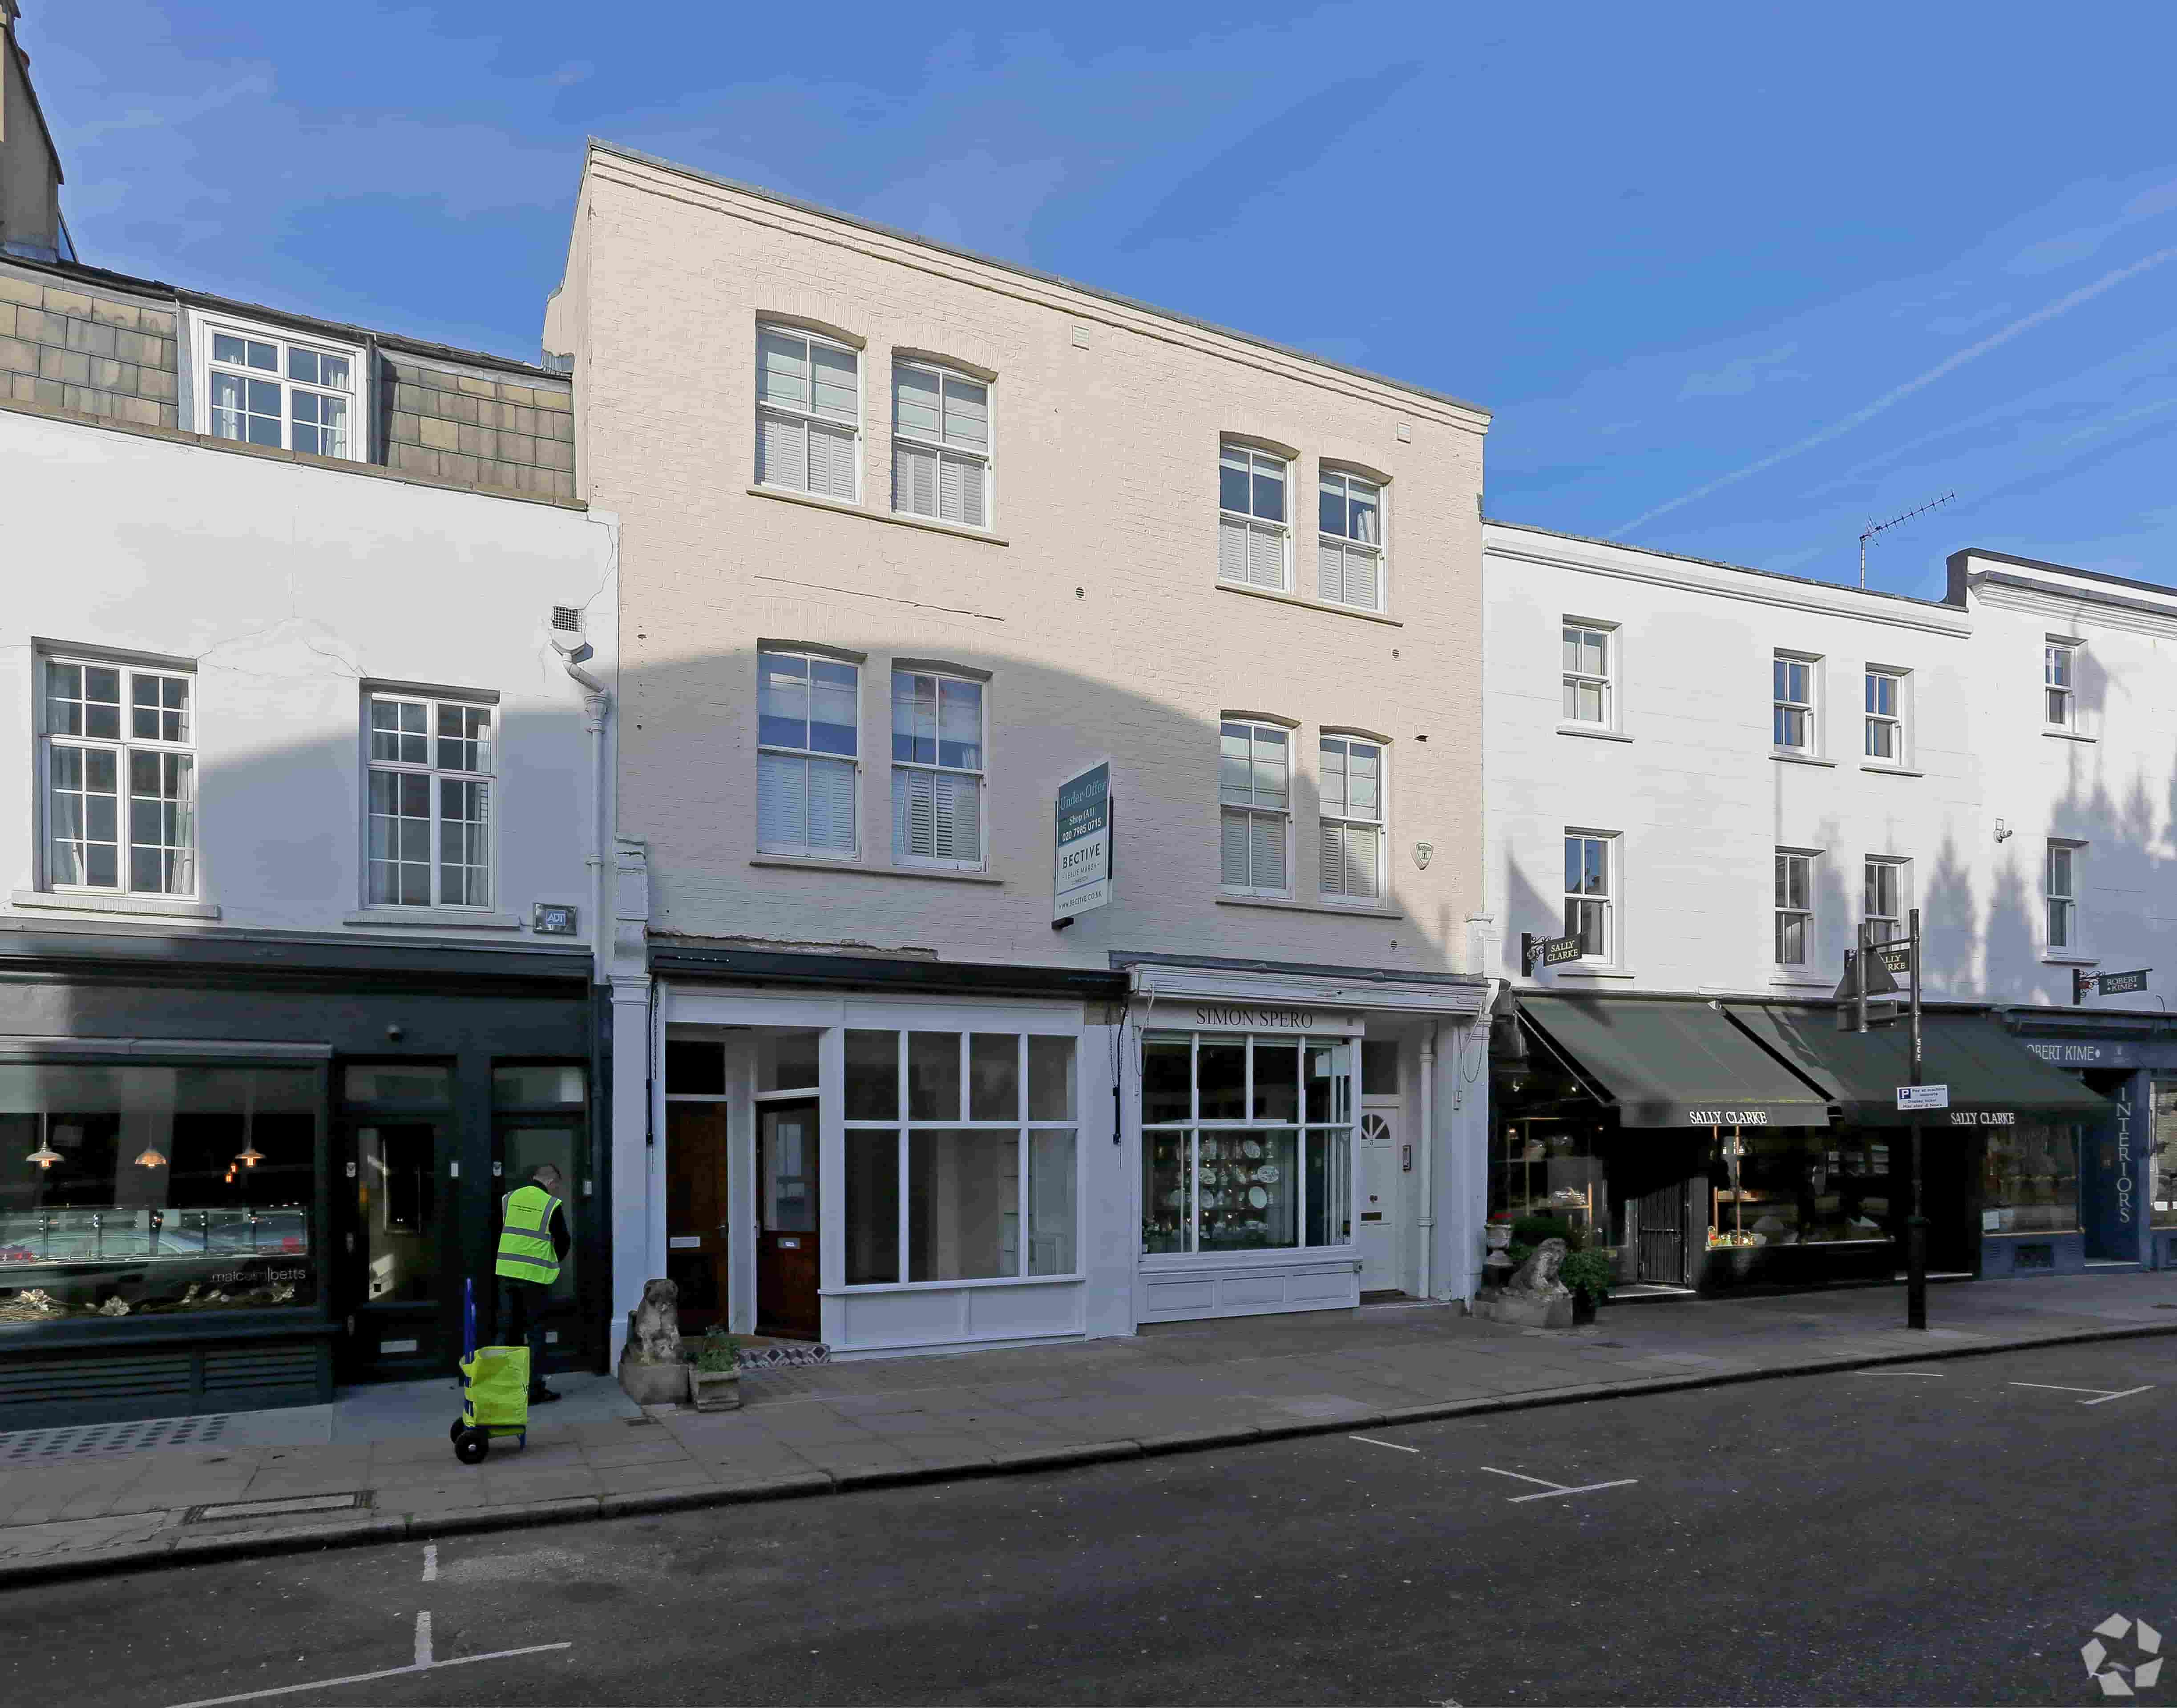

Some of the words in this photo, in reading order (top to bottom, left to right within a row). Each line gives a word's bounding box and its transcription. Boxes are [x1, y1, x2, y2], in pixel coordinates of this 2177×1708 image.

[1060, 791, 1085, 810] Under
[1086, 780, 1107, 798] Offer
[1069, 814, 1082, 826] Shop
[1062, 830, 1072, 842] 020
[1073, 824, 1086, 837] 7985
[1088, 817, 1102, 830] 0715
[1063, 843, 1100, 869] BECTIVE
[548, 913, 563, 922] ADT
[1551, 939, 1575, 952] SALLY
[1547, 949, 1579, 962] CLARKE
[2107, 975, 2138, 986] ROBERT
[2111, 982, 2133, 992] KIME
[1196, 1007, 1254, 1025] SIMON
[1260, 1010, 1313, 1028] SPERO
[2065, 1046, 2094, 1061] KIME
[1901, 1089, 1909, 1099] P
[1689, 1111, 1722, 1124] SALLY
[1726, 1111, 1767, 1125] CLARKE
[1951, 1112, 1977, 1125] SALLY
[1980, 1112, 2015, 1125] CLARKE
[2116, 1088, 2133, 1223] INTERIORS
